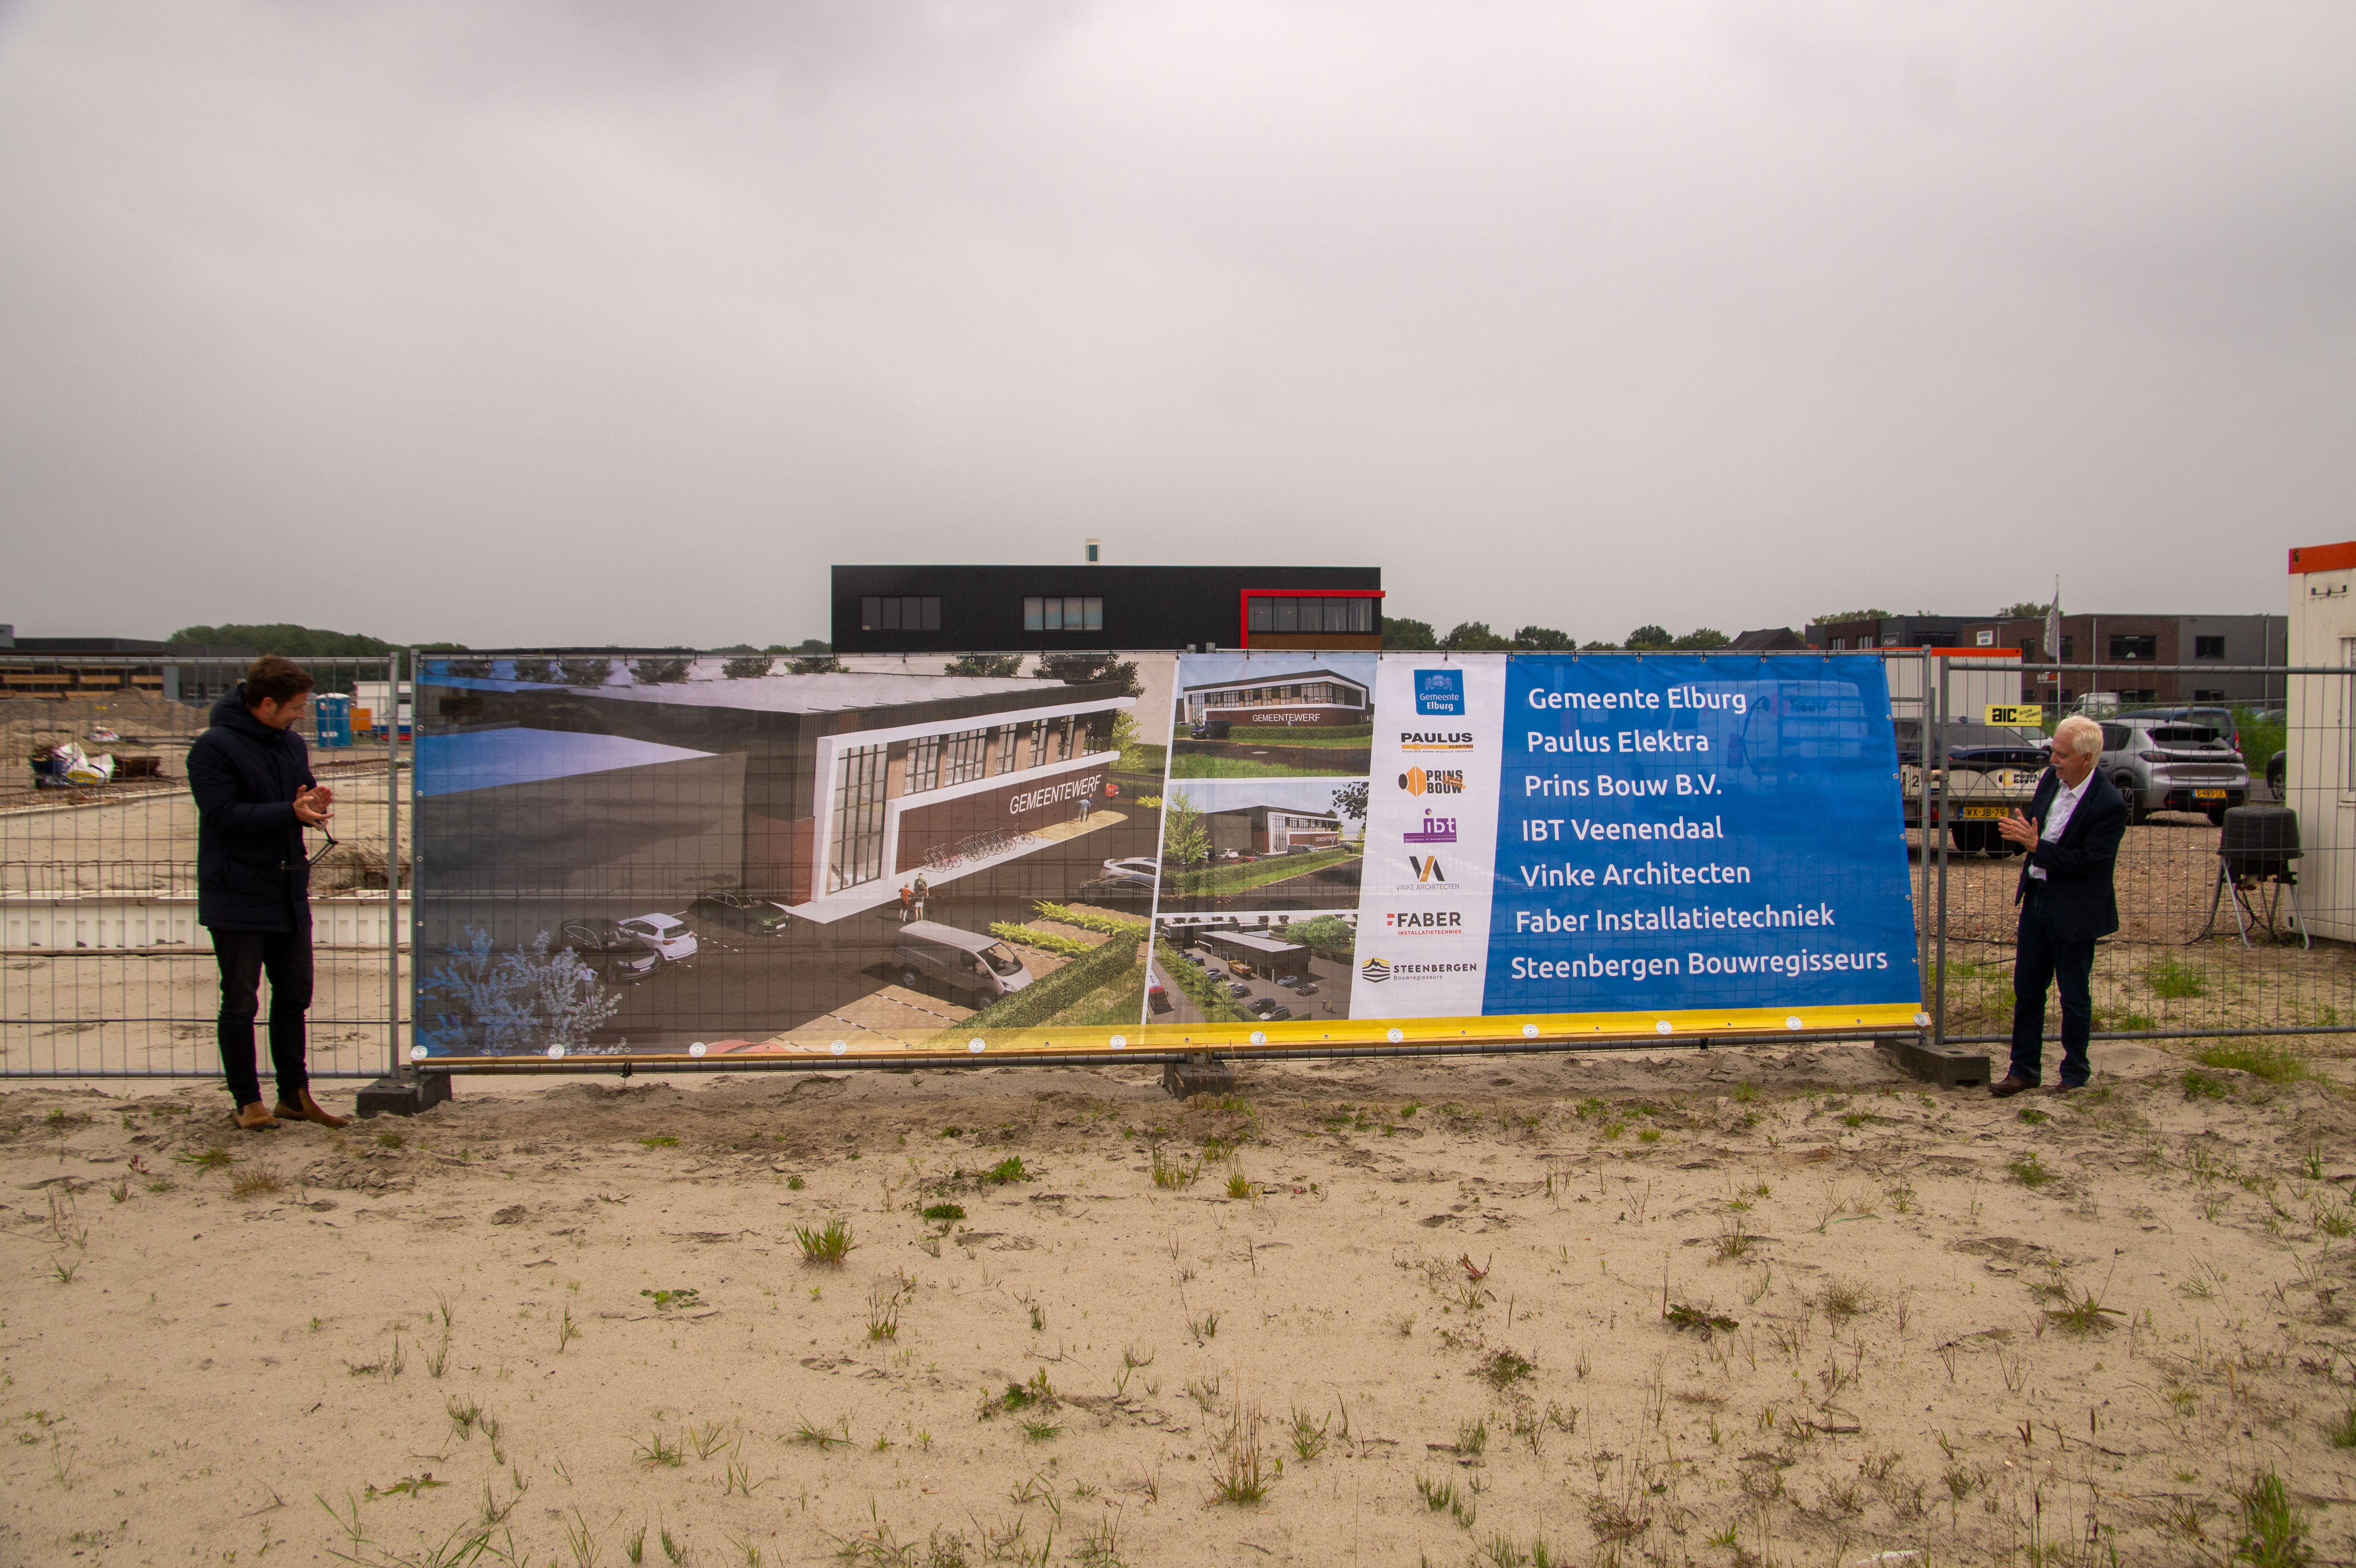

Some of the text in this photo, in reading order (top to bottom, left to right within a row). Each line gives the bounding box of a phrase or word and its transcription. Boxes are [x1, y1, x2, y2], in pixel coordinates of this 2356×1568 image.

[1420, 693, 1460, 701] Gemeente
[1427, 702, 1454, 711] Elburg
[1529, 686, 1747, 714] Gemeente Elburg
[1252, 713, 1320, 722] GEMEENTEWERF
[1401, 733, 1473, 743] PAULUS
[1527, 729, 1709, 752] Paulus Elektra
[1426, 770, 1463, 781] PRINS
[1010, 775, 1102, 815] GEMEENTEWERF
[1427, 782, 1462, 793] BOUW
[1525, 774, 1722, 797] Prins Bouw B.V.
[1523, 815, 1724, 841] IBT Veenendaal
[1520, 861, 1751, 887] Vinke Architecten
[1397, 912, 1462, 927] FABER
[1516, 903, 1836, 933] Faber Installatietechniek
[1393, 963, 1477, 973] STEENBERGEN
[1511, 948, 1888, 981] Steenbergen Bouwregisseurs
